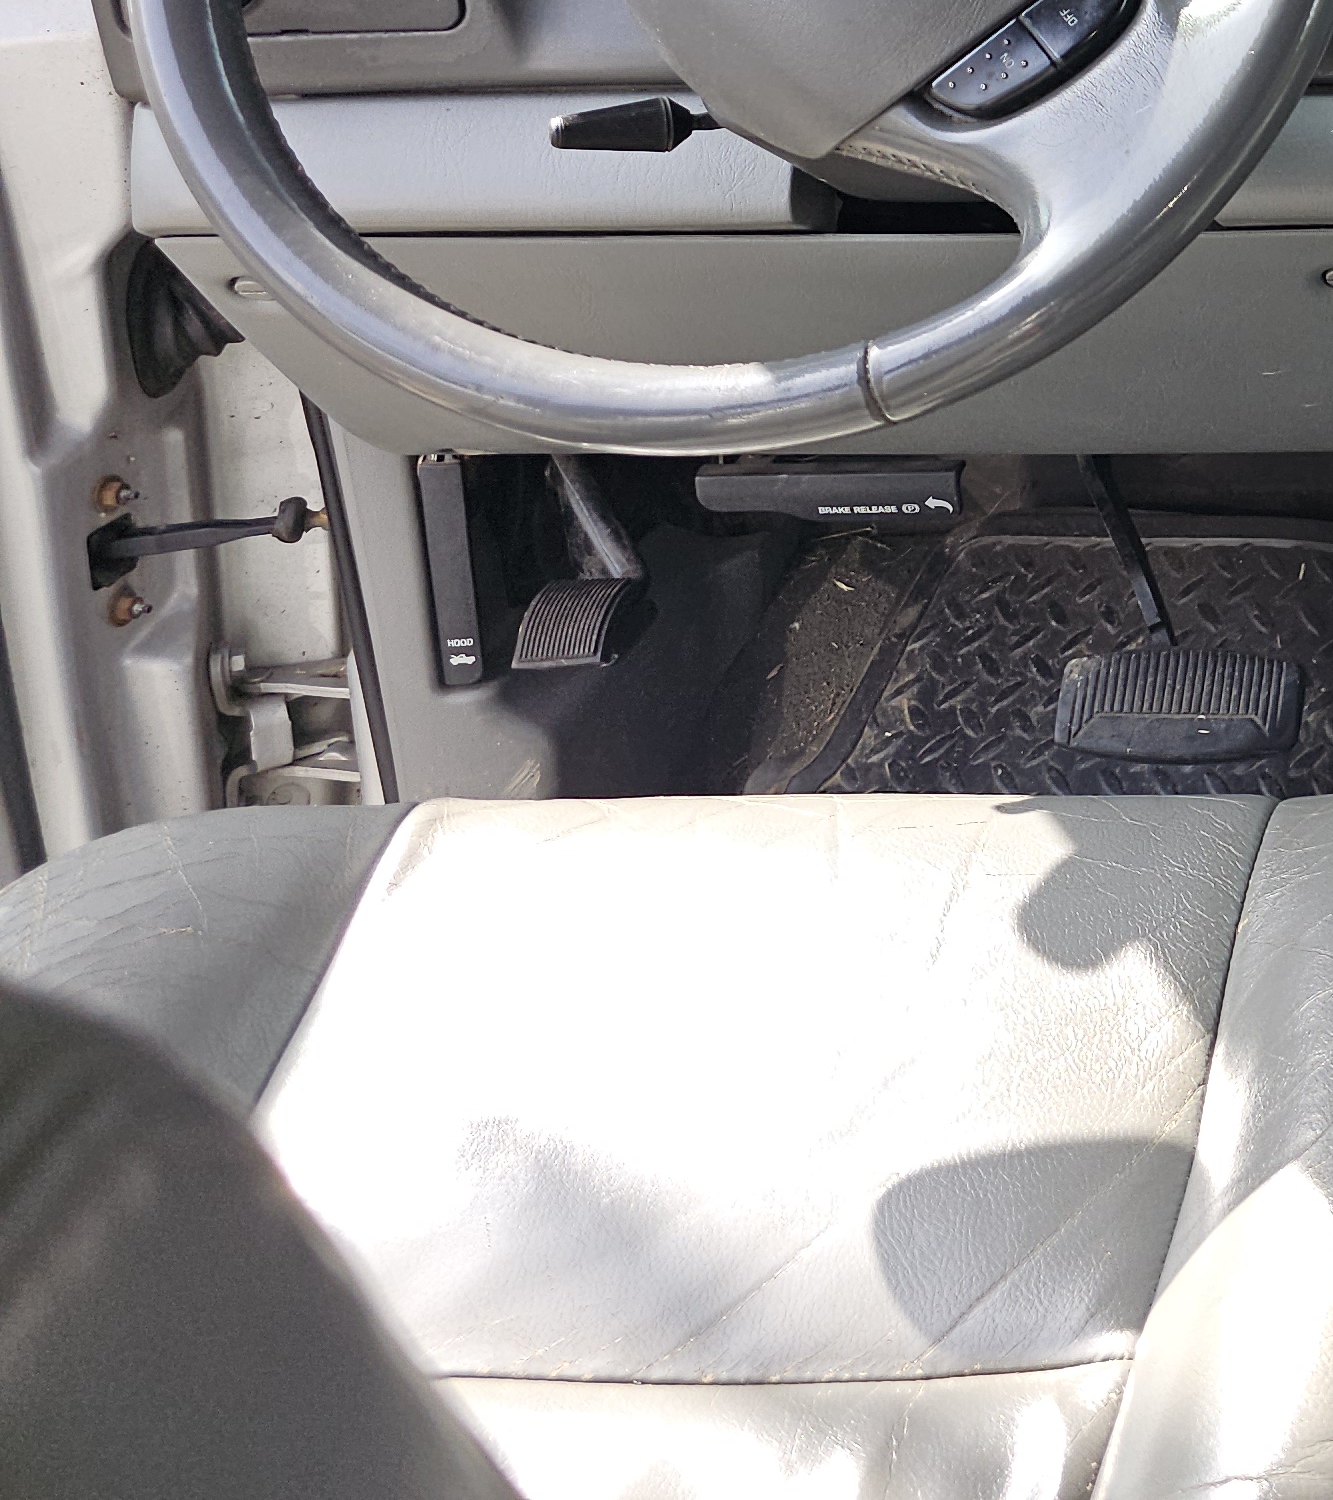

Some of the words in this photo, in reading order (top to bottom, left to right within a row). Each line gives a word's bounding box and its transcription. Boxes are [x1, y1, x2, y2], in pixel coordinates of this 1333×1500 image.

[1058, 8, 1079, 27] OFF
[999, 52, 1015, 68] ON
[818, 506, 852, 515] BRAKE
[853, 505, 899, 514] RELEASE
[446, 637, 474, 647] HOOD
